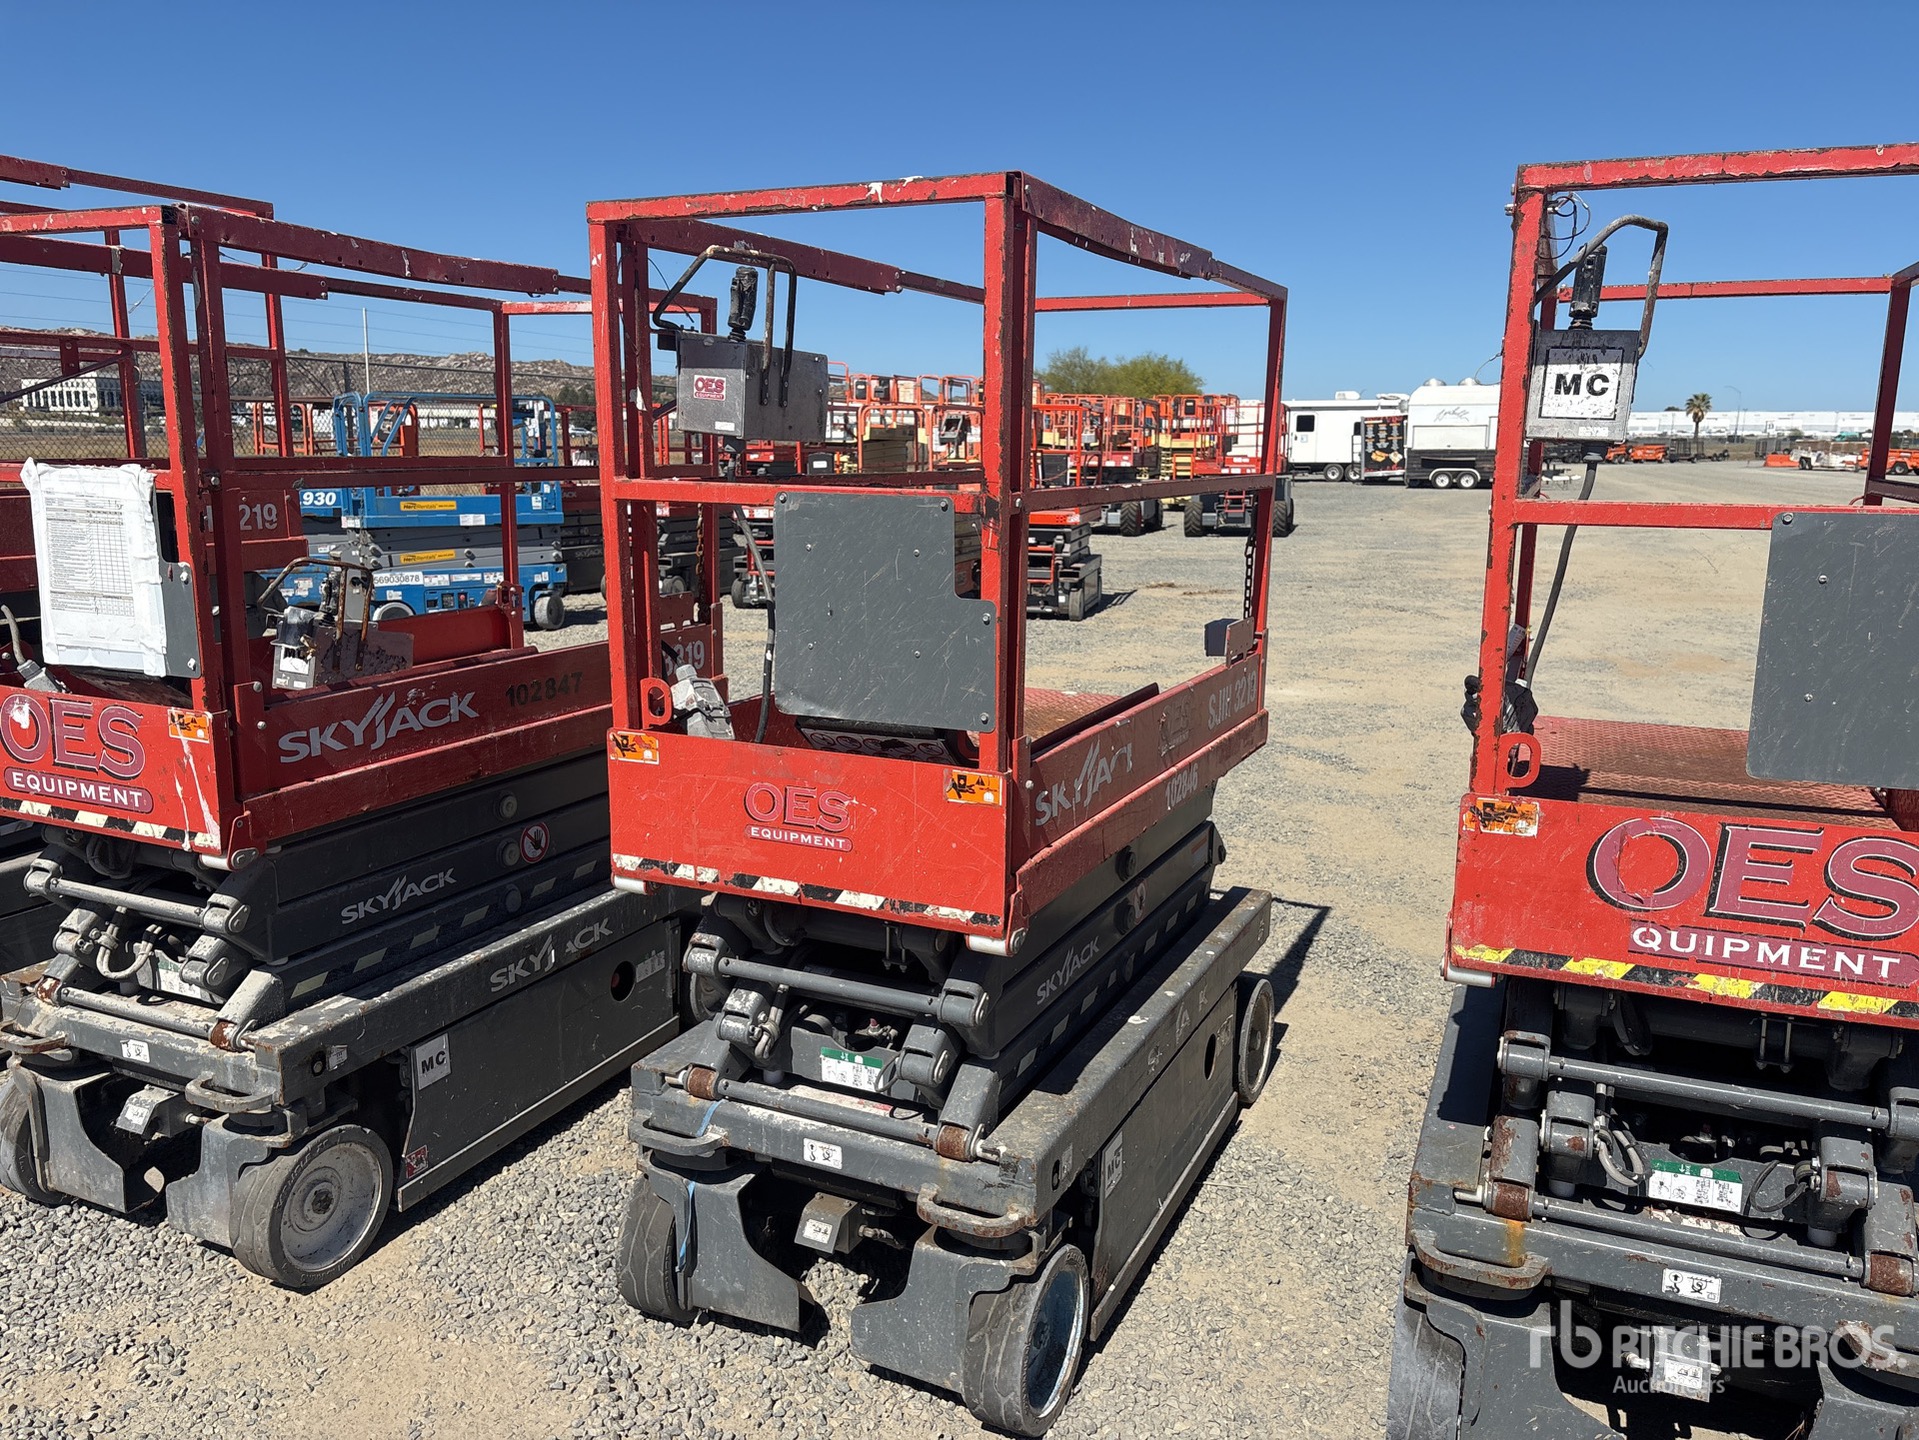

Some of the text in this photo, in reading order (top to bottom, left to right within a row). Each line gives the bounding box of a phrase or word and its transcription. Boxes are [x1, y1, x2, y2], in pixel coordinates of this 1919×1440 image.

[694, 377, 725, 394] OES
[1554, 373, 1610, 397] MC
[300, 491, 336, 506] 930
[0, 693, 146, 780] OES
[278, 671, 583, 763] SKYJACK 102847
[12, 772, 142, 808] EQUIPMENT
[744, 782, 851, 832] OES
[750, 826, 846, 849] EQUIPMENT
[341, 868, 457, 925] SKYJACK
[1585, 816, 1919, 942] OES
[1036, 936, 1100, 1006] SKYJACK
[421, 1051, 446, 1074] MC
